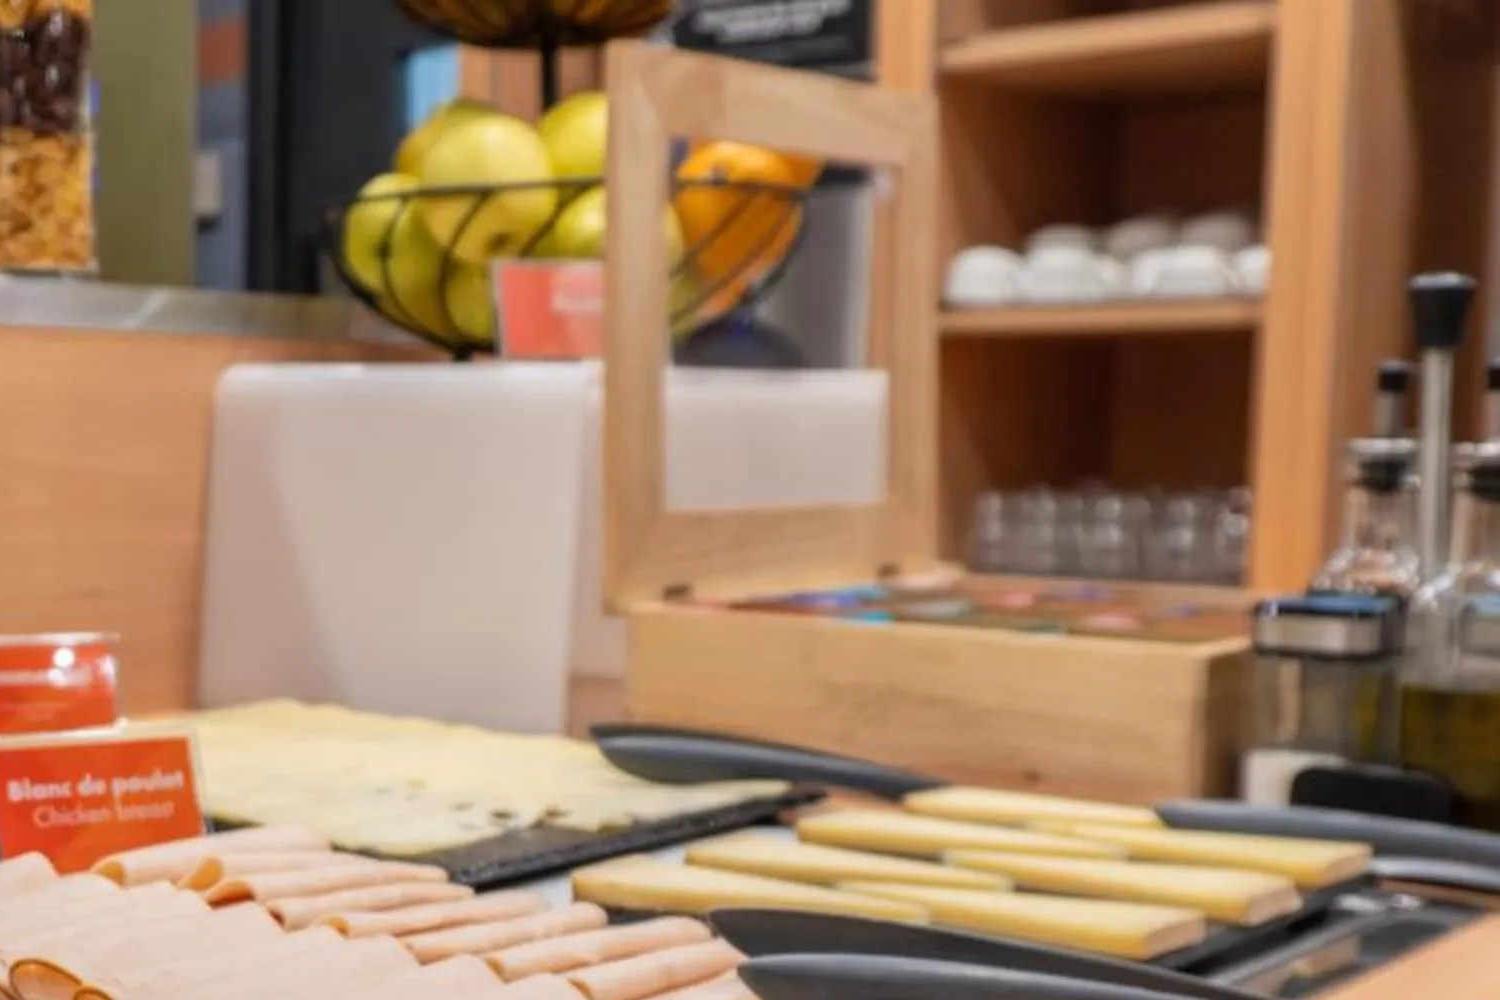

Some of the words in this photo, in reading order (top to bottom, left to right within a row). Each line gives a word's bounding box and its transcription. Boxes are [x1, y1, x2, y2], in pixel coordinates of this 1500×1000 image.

[7, 776, 72, 803] Blanc
[77, 772, 107, 796] de
[111, 767, 184, 803] poulet
[32, 801, 110, 828] Chicken
[116, 799, 175, 823] breast
